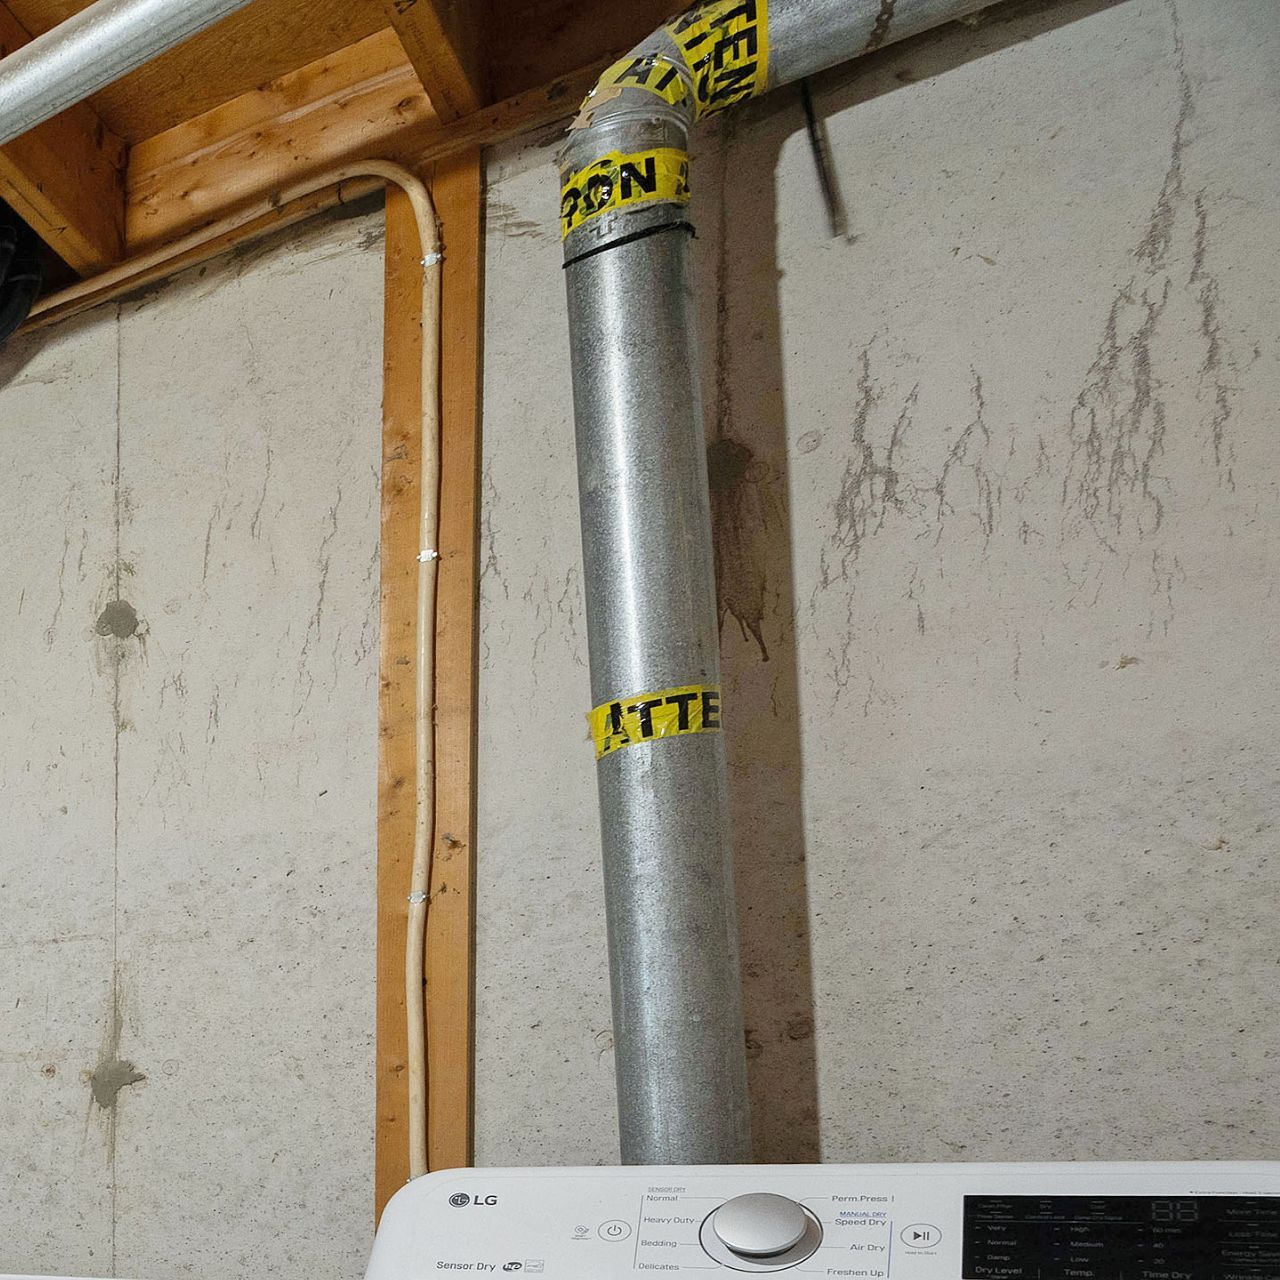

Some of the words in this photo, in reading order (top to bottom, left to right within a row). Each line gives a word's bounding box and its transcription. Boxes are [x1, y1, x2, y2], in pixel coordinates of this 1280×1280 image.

[473, 1194, 498, 1206] LG
[646, 1194, 678, 1202] Normal
[860, 1195, 888, 1203] Press
[643, 1216, 672, 1225] Heavy
[673, 1216, 695, 1225] Duty
[834, 1218, 865, 1228] Speed
[867, 1218, 887, 1227] Dry
[641, 1239, 678, 1248] Bedding
[867, 1244, 886, 1253] Dry
[436, 1260, 474, 1270] Sensor
[476, 1261, 496, 1272] Dry
[638, 1262, 680, 1271] Delicates
[975, 1266, 994, 1274] Dry
[995, 1266, 1023, 1275] Level
[827, 1267, 868, 1276] Freshen
[870, 1268, 885, 1278] Up
[1142, 1270, 1169, 1278] Time
[1171, 1271, 1193, 1280] Dry
